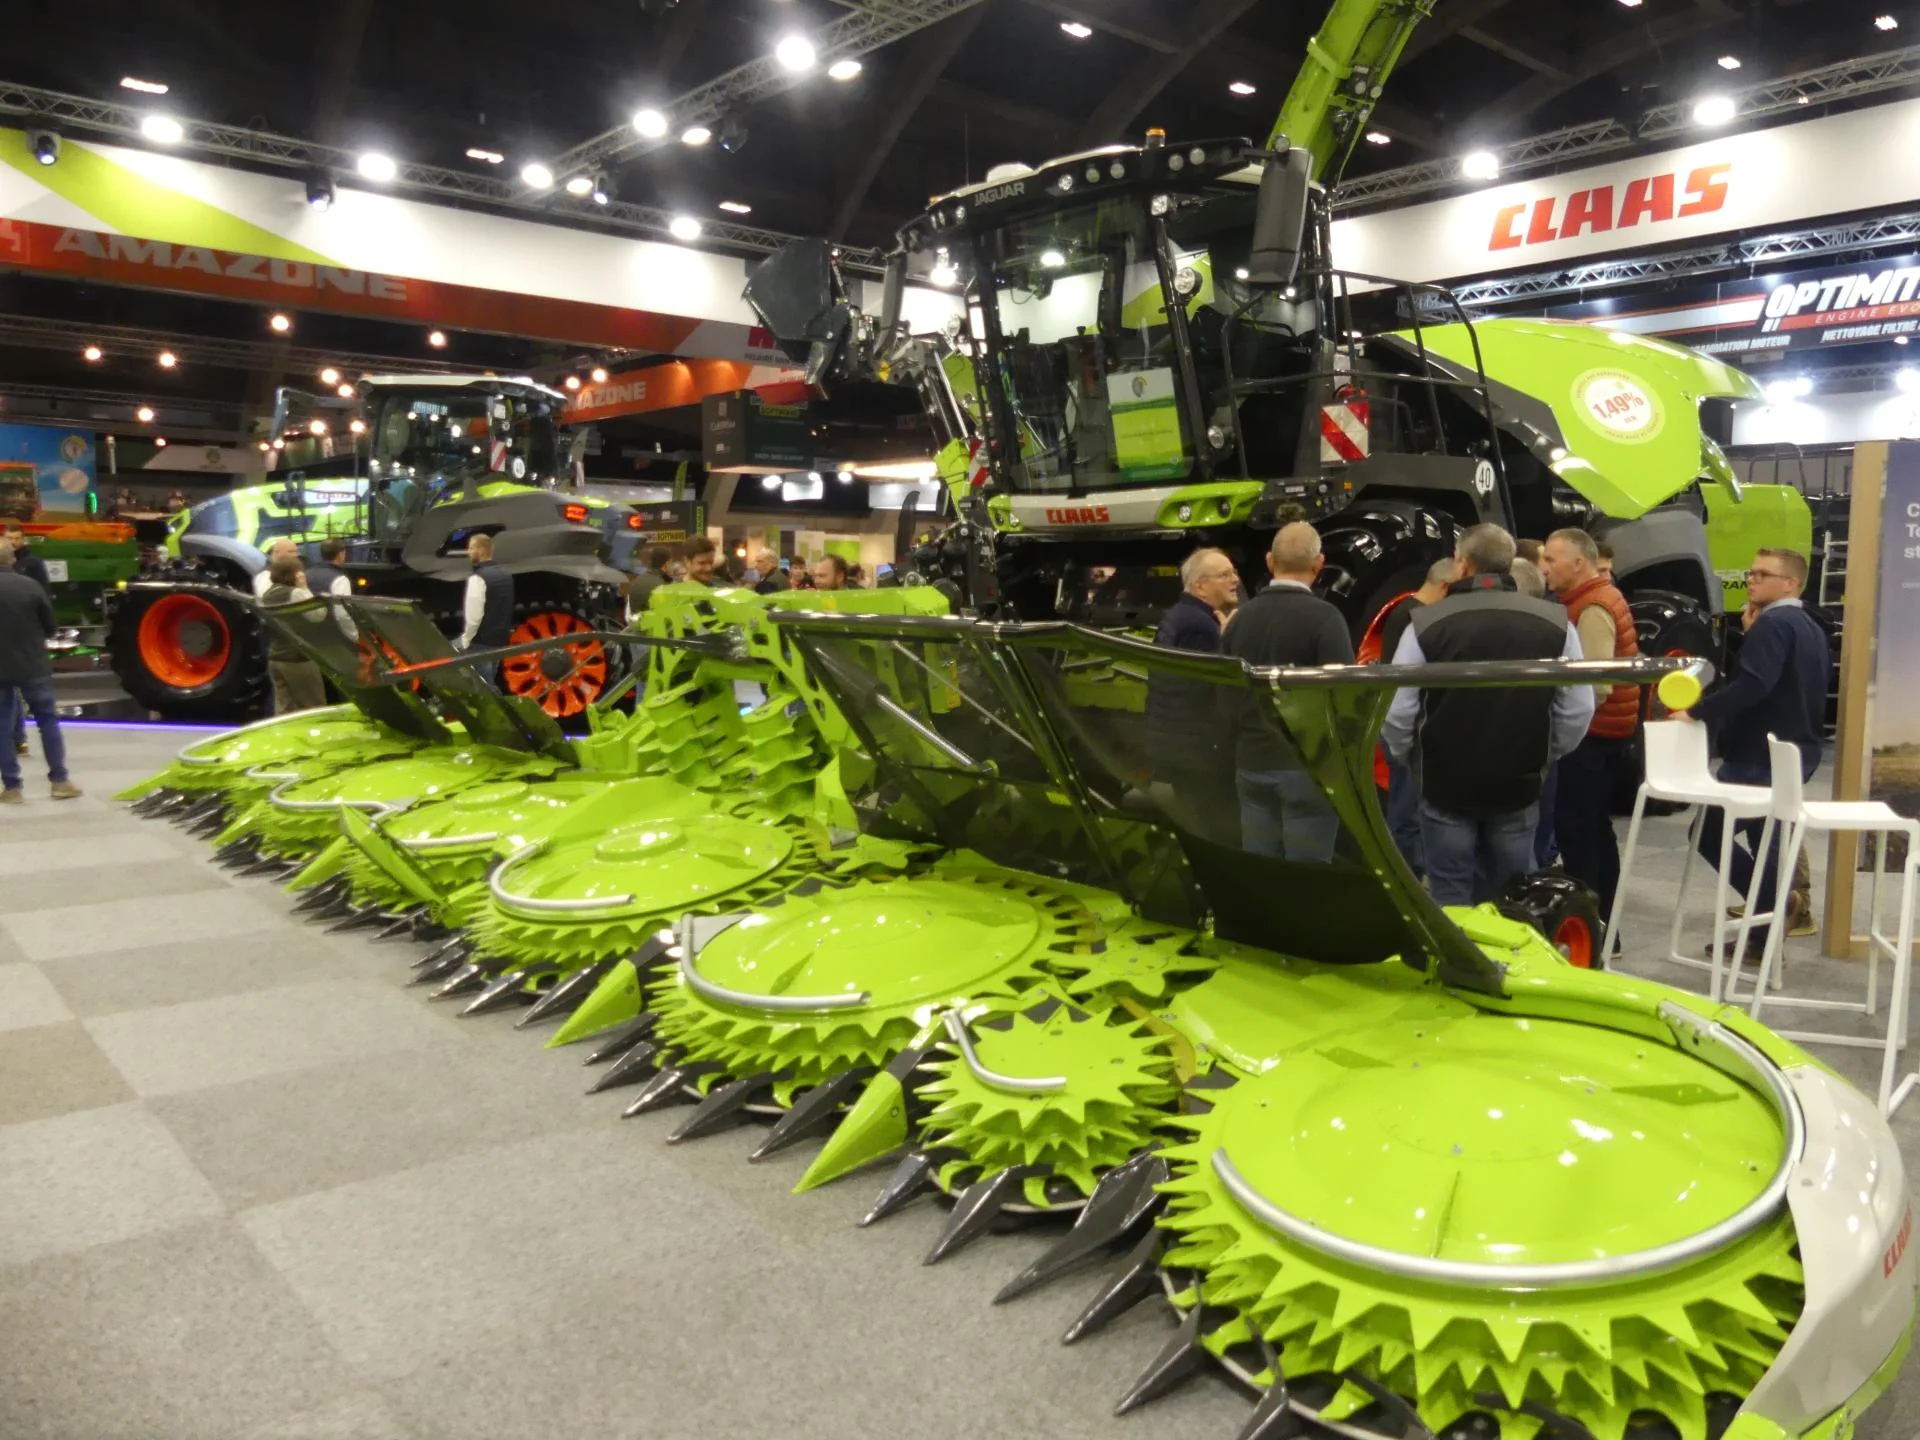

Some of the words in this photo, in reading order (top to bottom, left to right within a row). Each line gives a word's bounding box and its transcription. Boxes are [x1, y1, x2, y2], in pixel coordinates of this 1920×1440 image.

[974, 182, 1025, 207] JAGUAR
[1488, 164, 1732, 252] CLAAS
[53, 226, 408, 301] AMAZONE
[1765, 266, 1920, 318] OPTIMIT
[1815, 308, 1879, 324] ENGINE
[1749, 335, 1791, 349] MOTEUR
[1821, 325, 1882, 342] NETTOYAGE
[1882, 320, 1918, 335] FILTRE
[1592, 391, 1645, 419] 1,49%
[1479, 467, 1491, 489] 40
[1045, 505, 1110, 524] CLAAS
